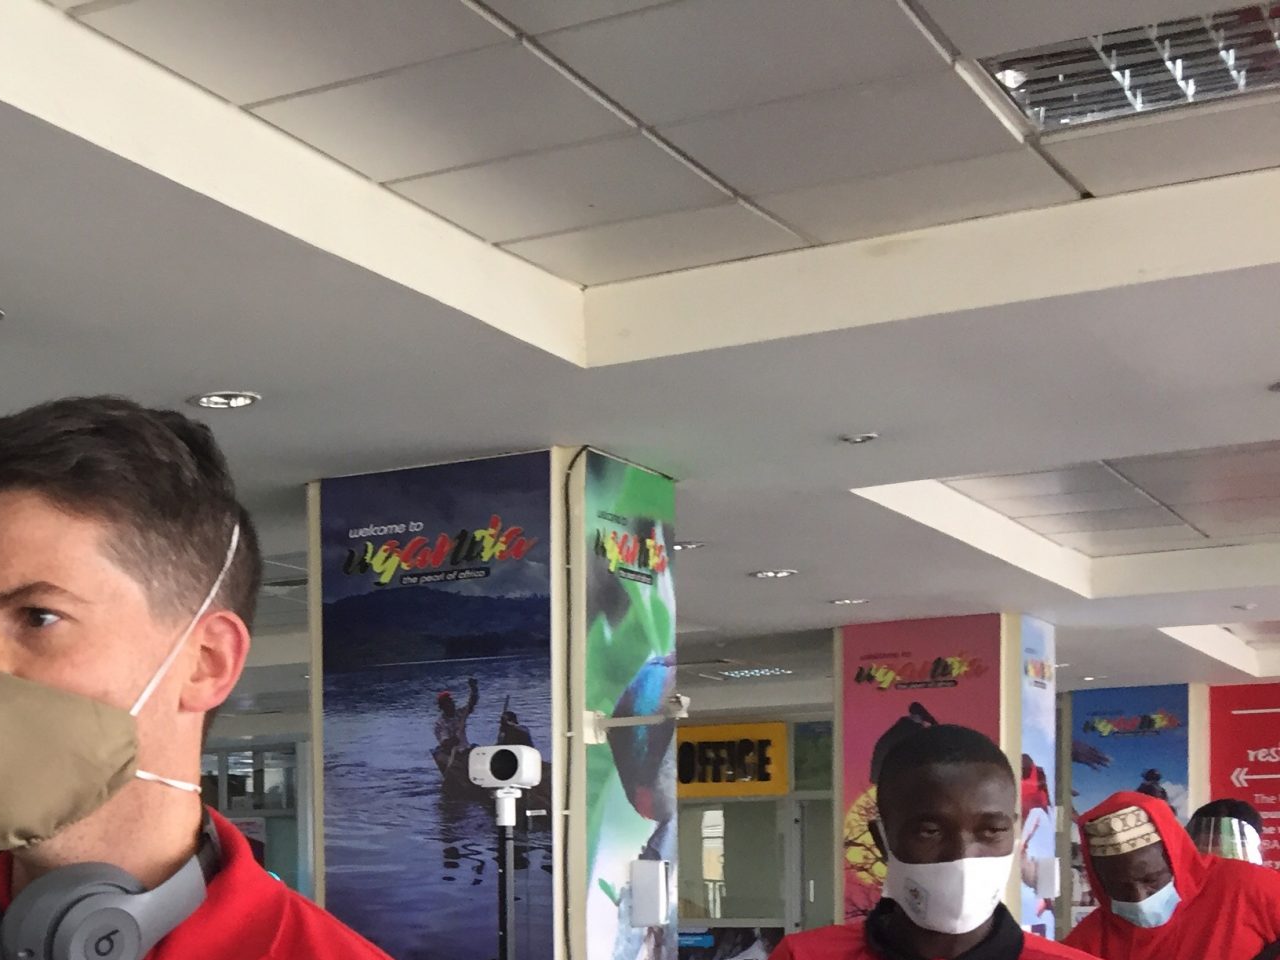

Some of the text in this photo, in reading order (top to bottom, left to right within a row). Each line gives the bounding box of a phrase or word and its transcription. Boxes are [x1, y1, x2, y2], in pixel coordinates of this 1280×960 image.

[348, 521, 424, 539] welcome to
[401, 569, 486, 585] the pearl of africa
[678, 739, 771, 784] OFFICE
[1247, 745, 1280, 762] res
